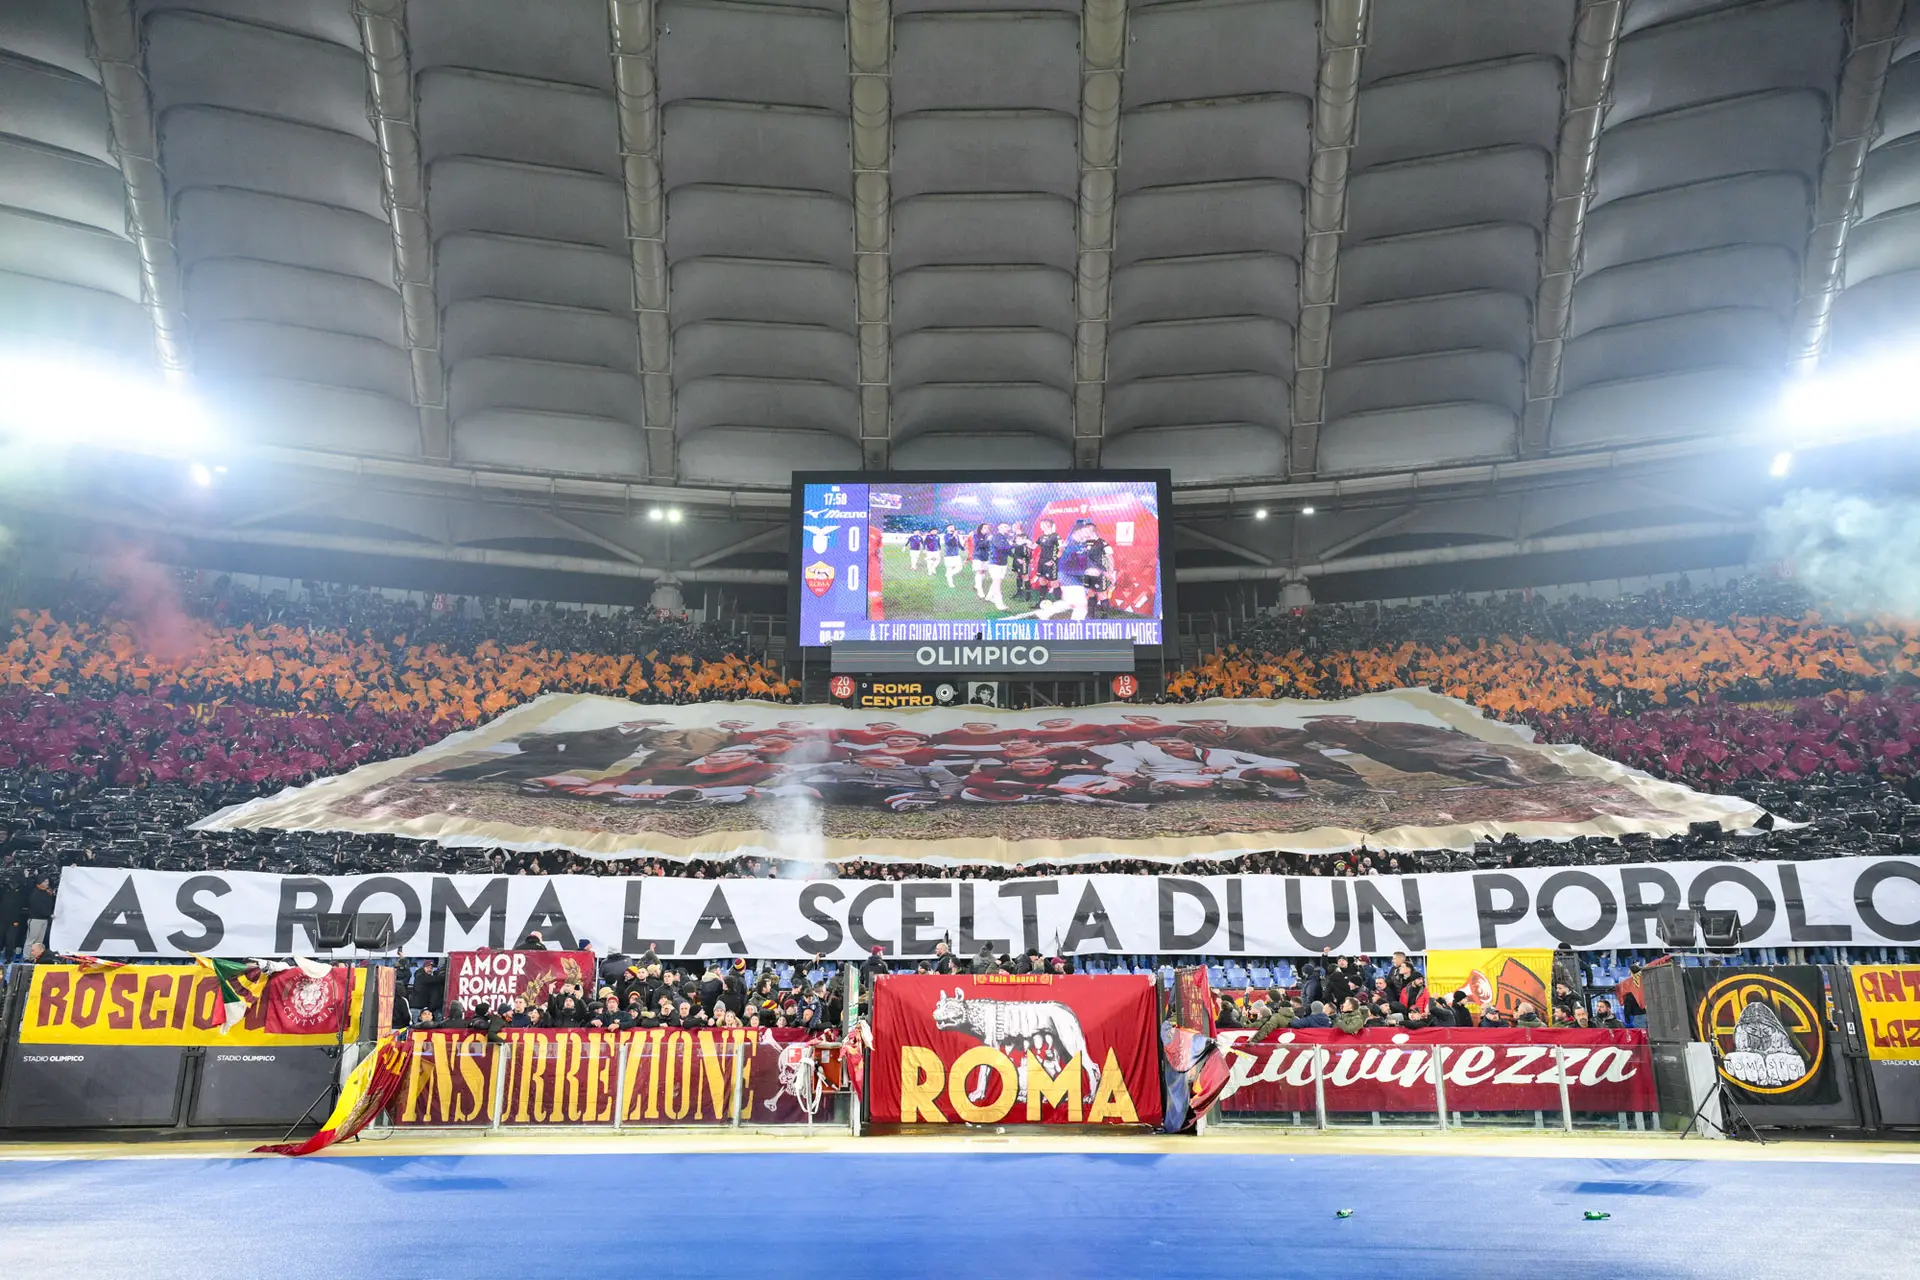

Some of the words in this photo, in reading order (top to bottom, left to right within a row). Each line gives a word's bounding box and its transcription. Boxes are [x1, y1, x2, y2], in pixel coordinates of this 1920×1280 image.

[848, 527, 860, 551] 0
[847, 565, 859, 590] 0
[916, 646, 1049, 665] OLIMPICO
[837, 676, 850, 686] 20
[873, 684, 922, 693] ROMA
[1118, 676, 1130, 685] 19
[1118, 685, 1132, 695] AS
[835, 686, 851, 696] AD
[861, 695, 934, 706] CENTRO
[79, 874, 232, 953] AS
[275, 876, 579, 953] ROMA
[622, 879, 748, 956] LA
[795, 878, 1124, 955] SCELTA
[1157, 877, 1245, 952] DI
[1283, 878, 1427, 954] UN
[459, 953, 527, 975] AMOR
[459, 975, 517, 994] ROMAE
[401, 1030, 758, 1122] INSURREZIONE
[900, 1045, 1139, 1124] ROMA
